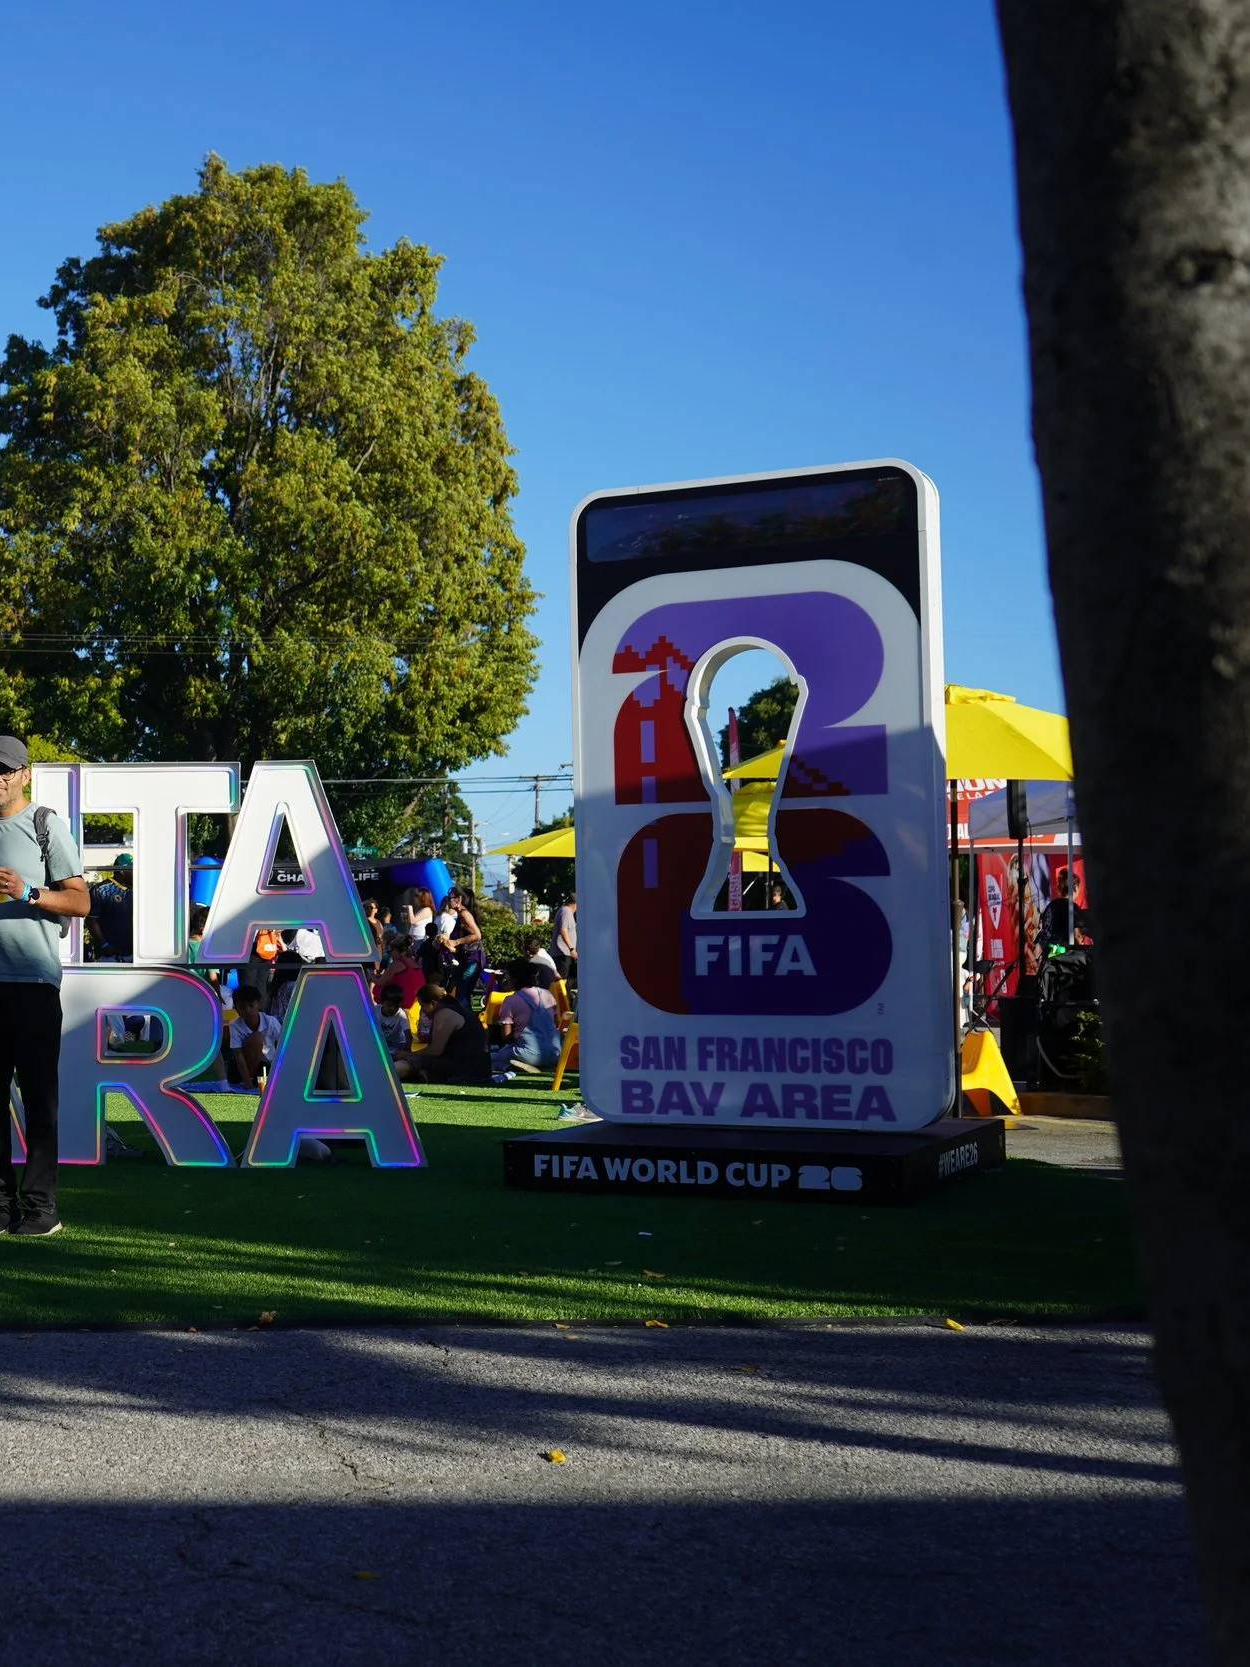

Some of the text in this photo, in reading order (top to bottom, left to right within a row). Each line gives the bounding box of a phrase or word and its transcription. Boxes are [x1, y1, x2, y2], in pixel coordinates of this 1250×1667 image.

[277, 873, 305, 882] CHA
[695, 934, 817, 976] FIFA
[620, 1035, 893, 1075] SAN FRANCISCO
[620, 1079, 897, 1122] BAY AREA
[533, 1153, 863, 1191] FIFA WORLD CUP 26
[937, 1140, 979, 1180] #WEARE26
